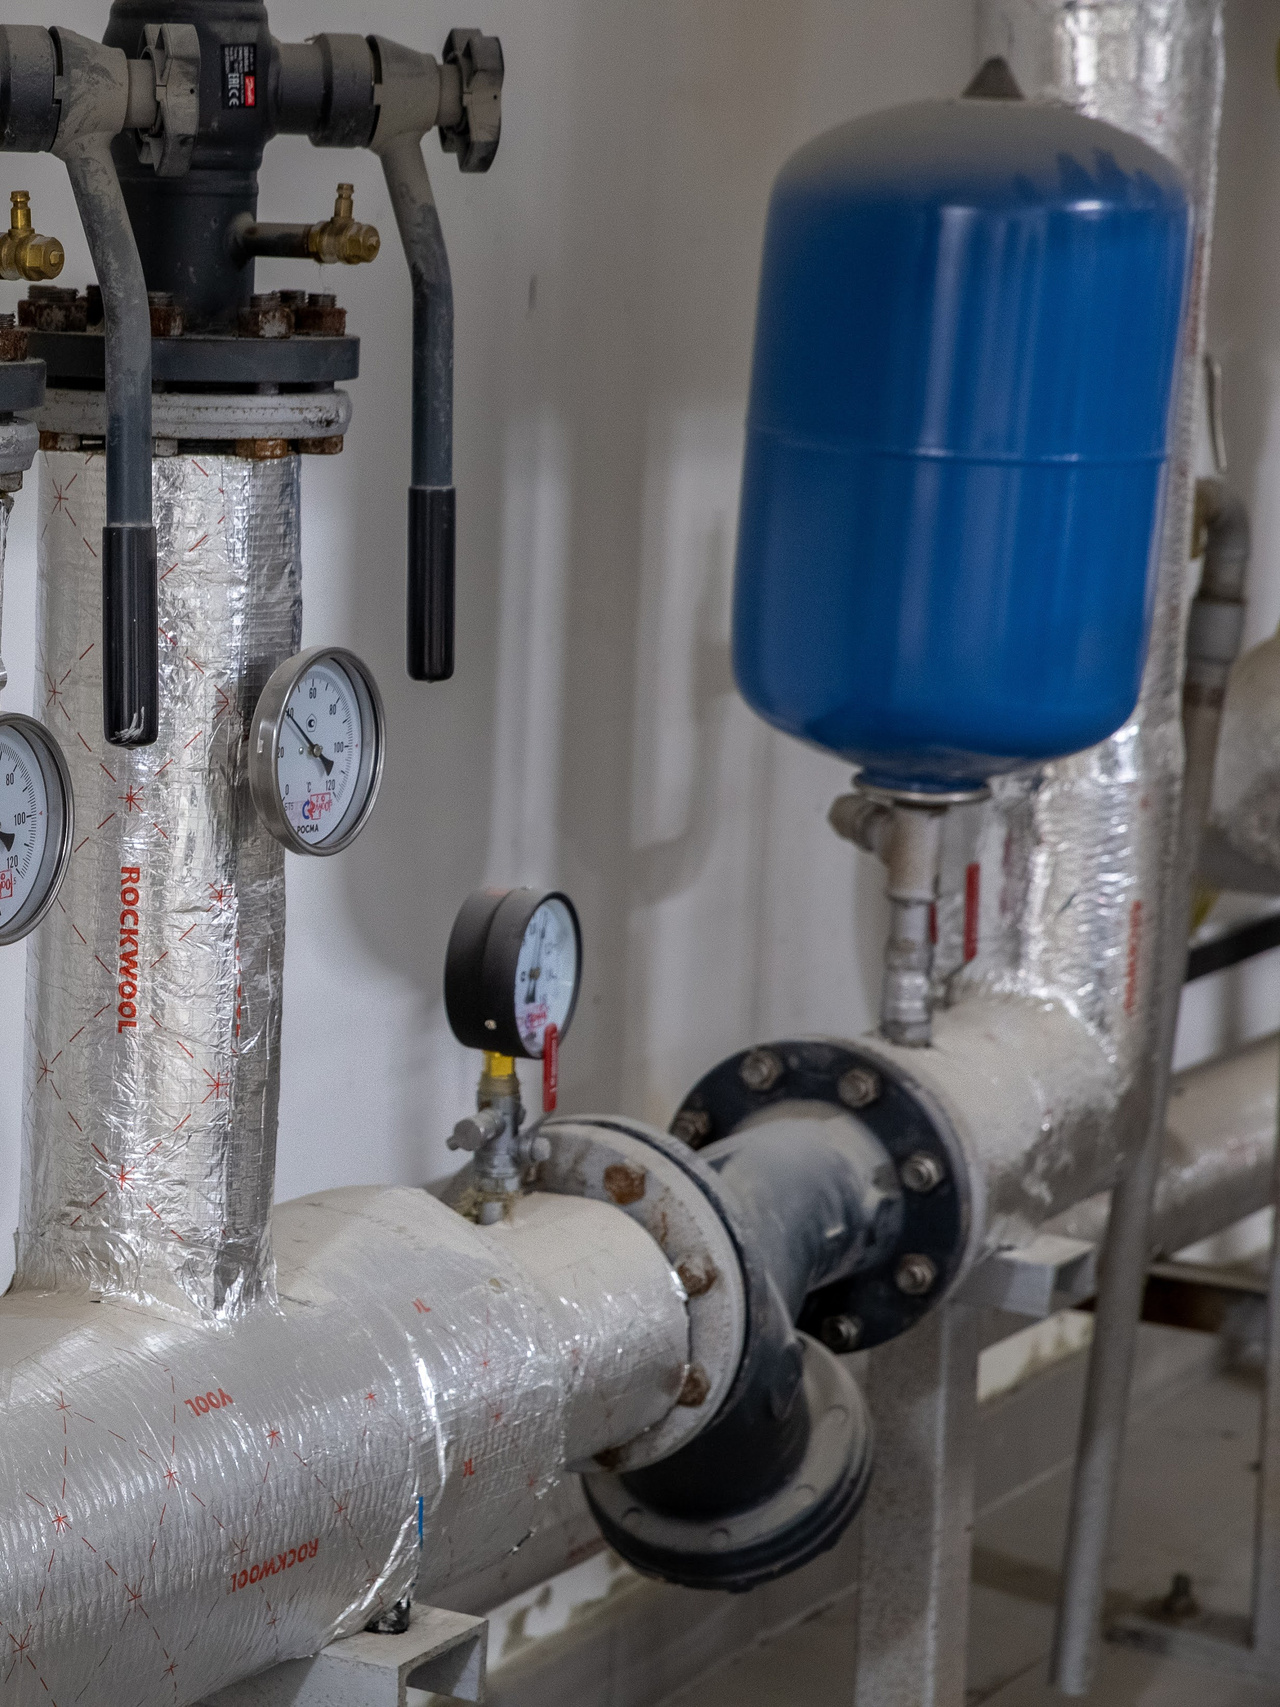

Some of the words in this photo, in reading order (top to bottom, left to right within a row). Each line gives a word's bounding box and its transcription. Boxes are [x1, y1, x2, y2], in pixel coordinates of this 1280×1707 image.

[309, 687, 317, 699] 60
[329, 704, 337, 716] 80
[334, 741, 344, 753] 100
[5, 772, 15, 786] 80
[325, 779, 336, 791] 120
[285, 783, 289, 794] 0
[14, 812, 26, 826] 100
[6, 855, 19, 870] 120
[117, 866, 141, 1034] ROCKWOOL
[230, 1537, 319, 1593] ROCKWOOL
